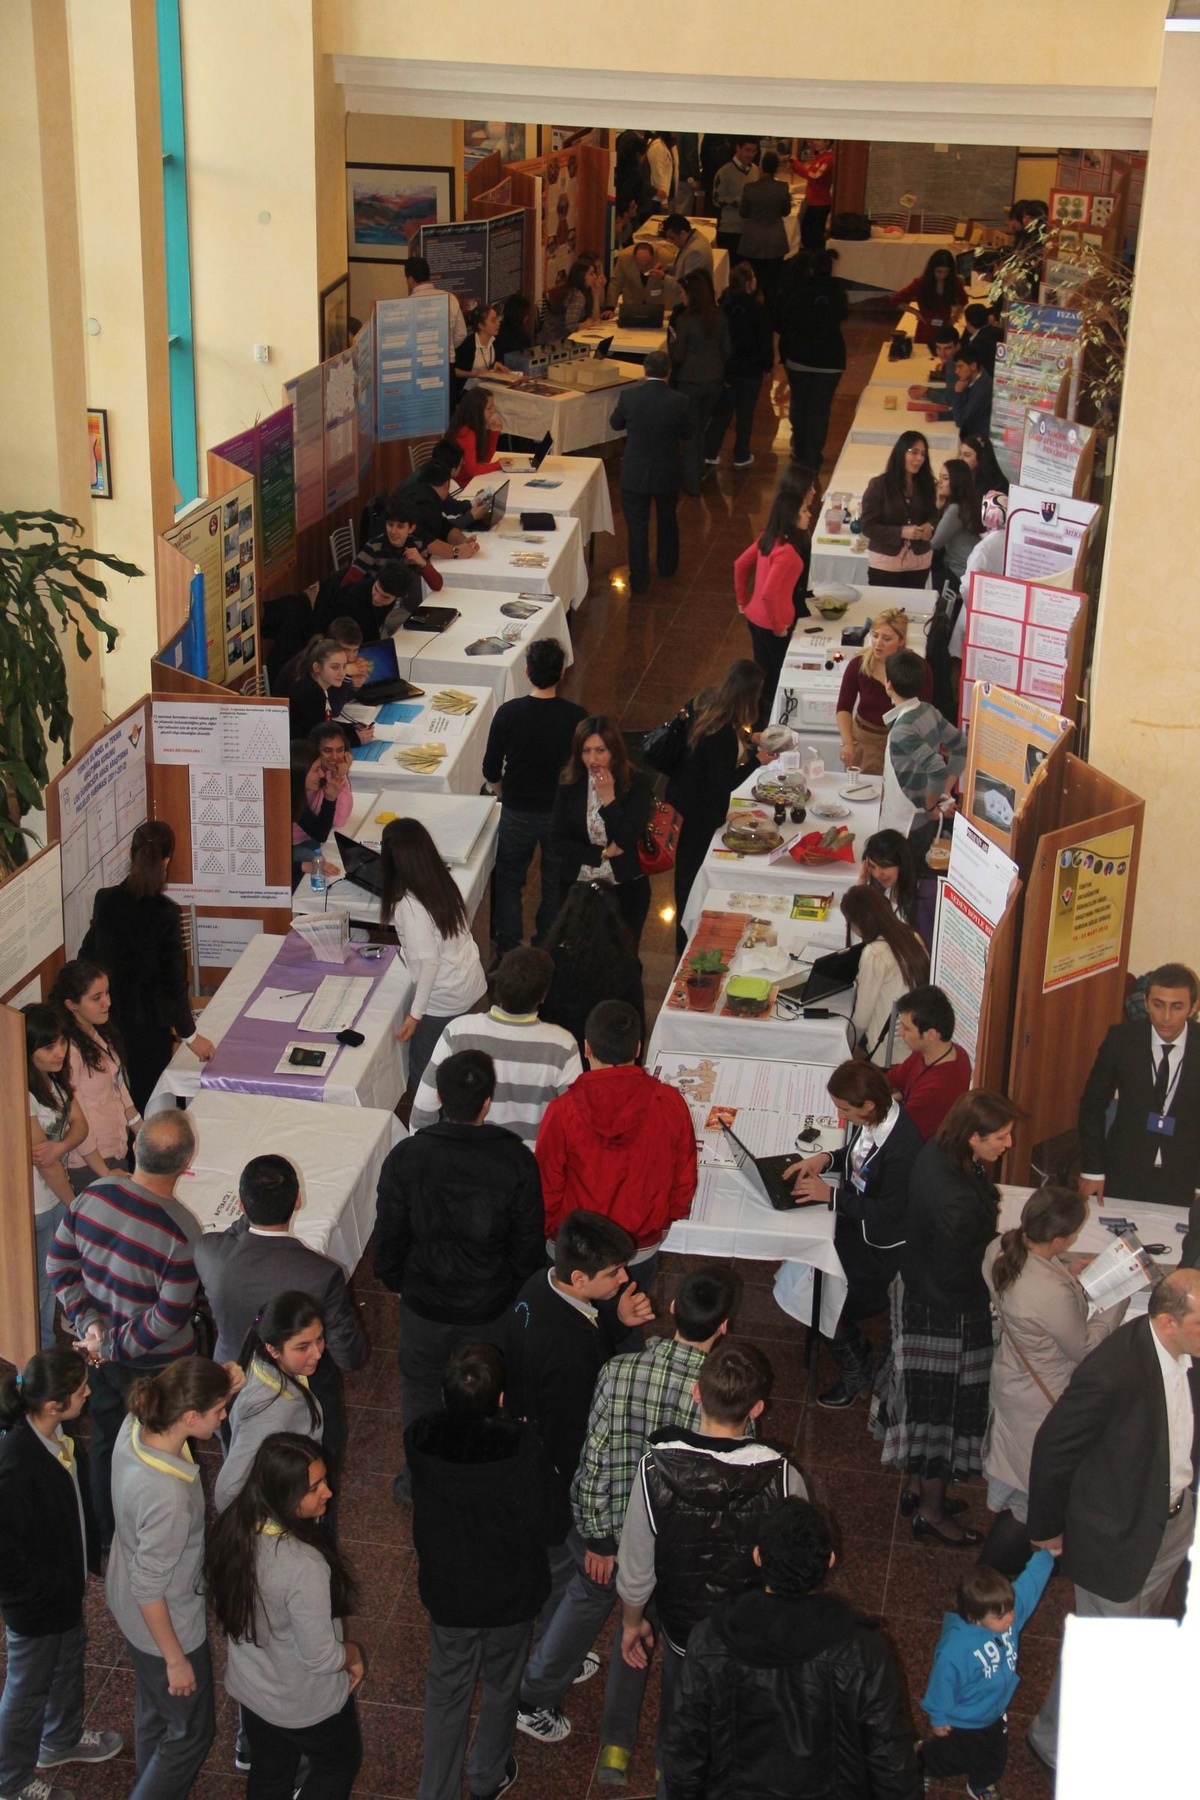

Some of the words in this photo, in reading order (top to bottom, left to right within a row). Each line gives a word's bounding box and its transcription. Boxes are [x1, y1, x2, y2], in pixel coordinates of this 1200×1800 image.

[1057, 311, 1076, 320] FEZA
[950, 893, 968, 912] NEDEN
[968, 908, 985, 929] BÖYLE
